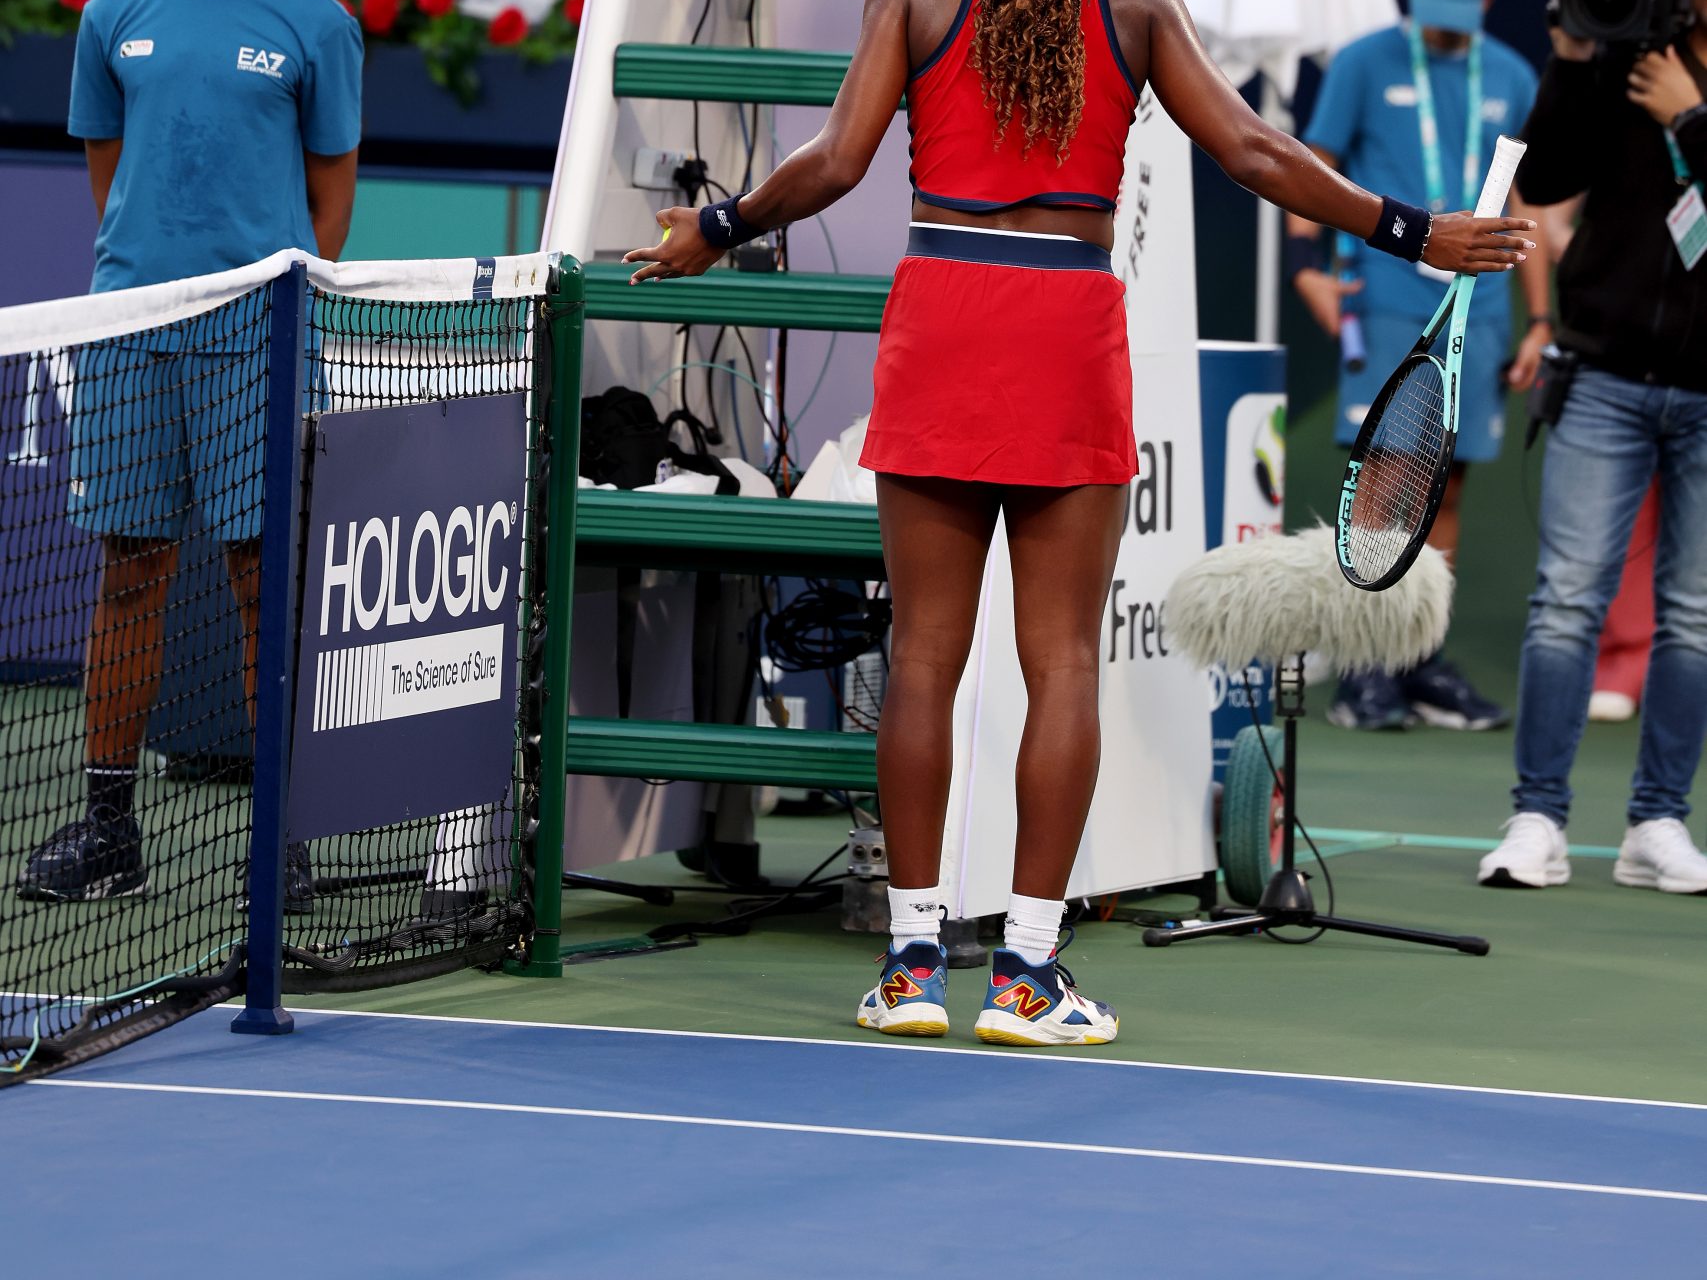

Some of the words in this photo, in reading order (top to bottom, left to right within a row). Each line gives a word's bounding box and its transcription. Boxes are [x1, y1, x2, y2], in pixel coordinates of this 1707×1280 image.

[238, 46, 286, 71] EA7
[391, 664, 412, 695] The
[415, 660, 458, 692] Science
[461, 652, 473, 684] of
[474, 650, 496, 681] Sure
